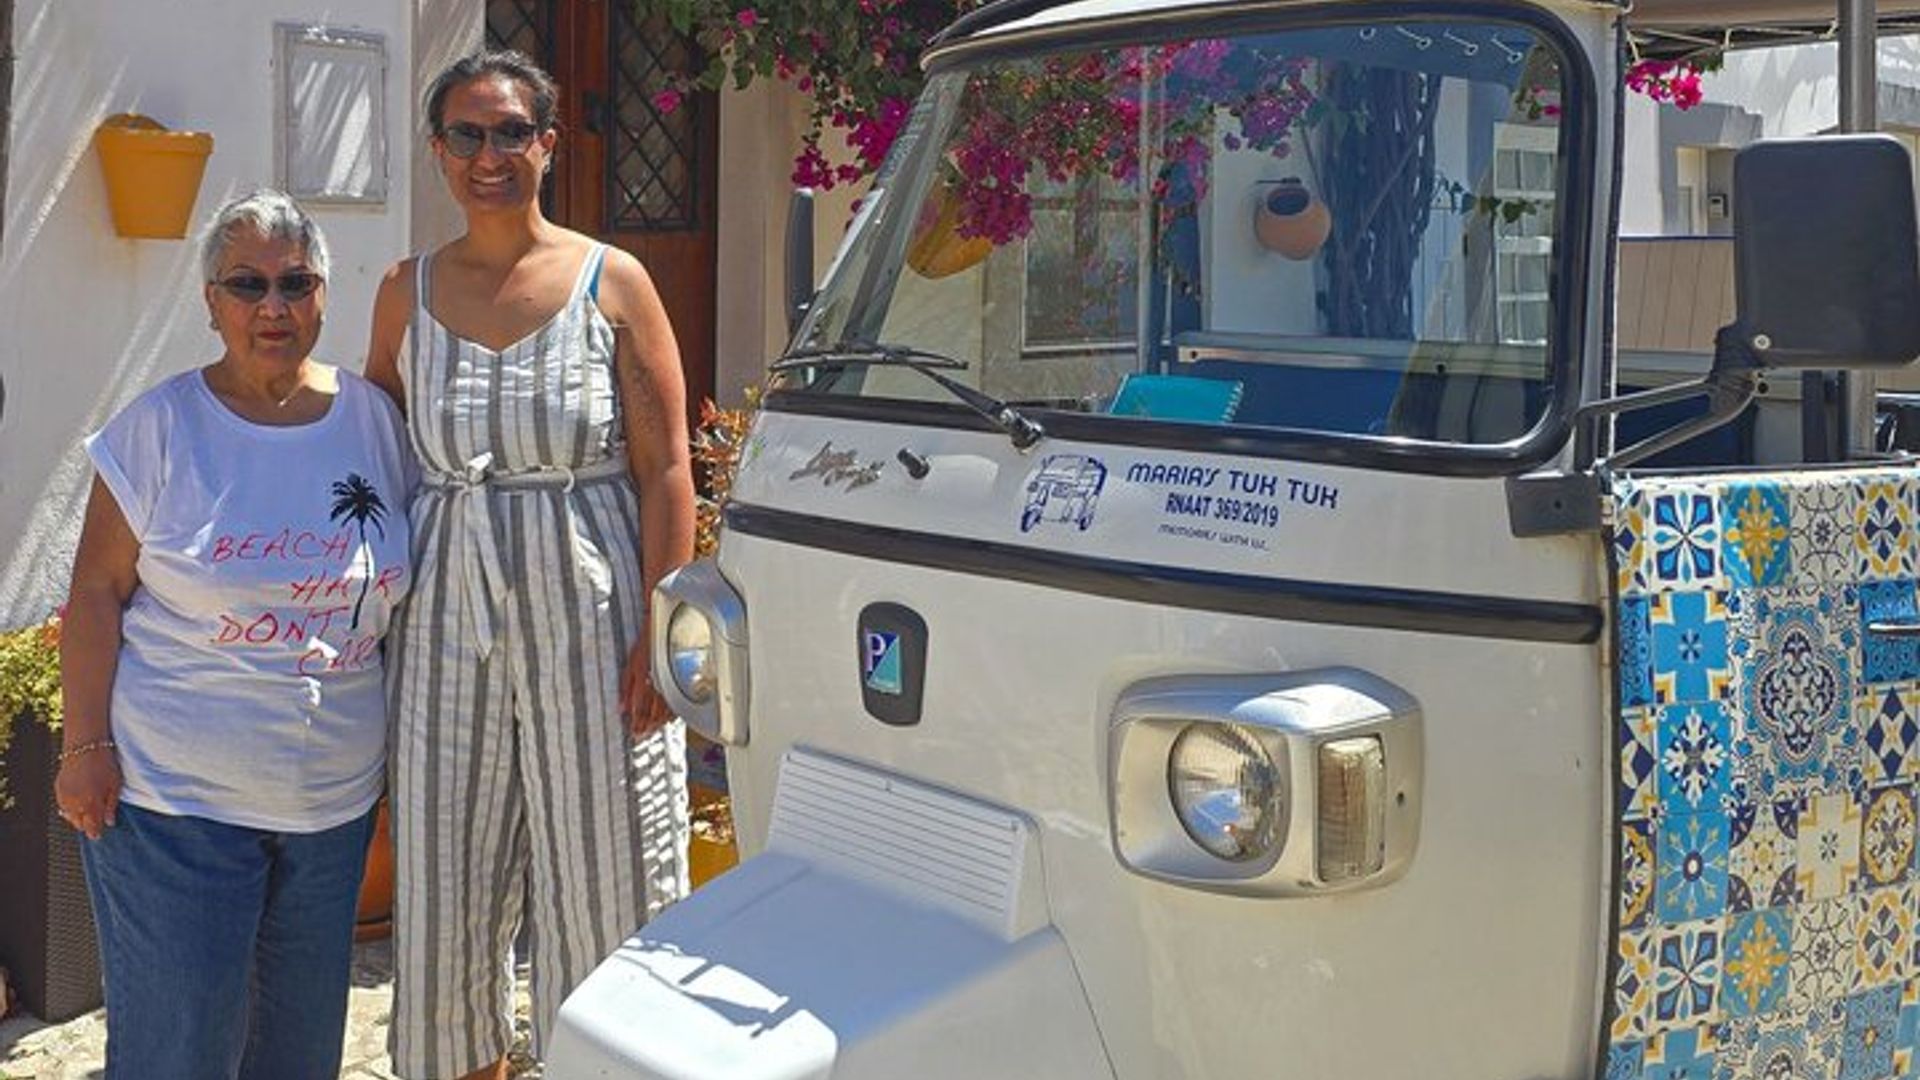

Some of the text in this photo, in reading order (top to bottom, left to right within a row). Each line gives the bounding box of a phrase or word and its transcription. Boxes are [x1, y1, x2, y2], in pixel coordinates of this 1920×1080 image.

[1127, 463, 1338, 509] MARIA'S TUK TUK
[1165, 493, 1212, 517] RNAAT
[213, 527, 352, 562] BEACH
[298, 636, 375, 676] CAR
[865, 632, 886, 671] P
